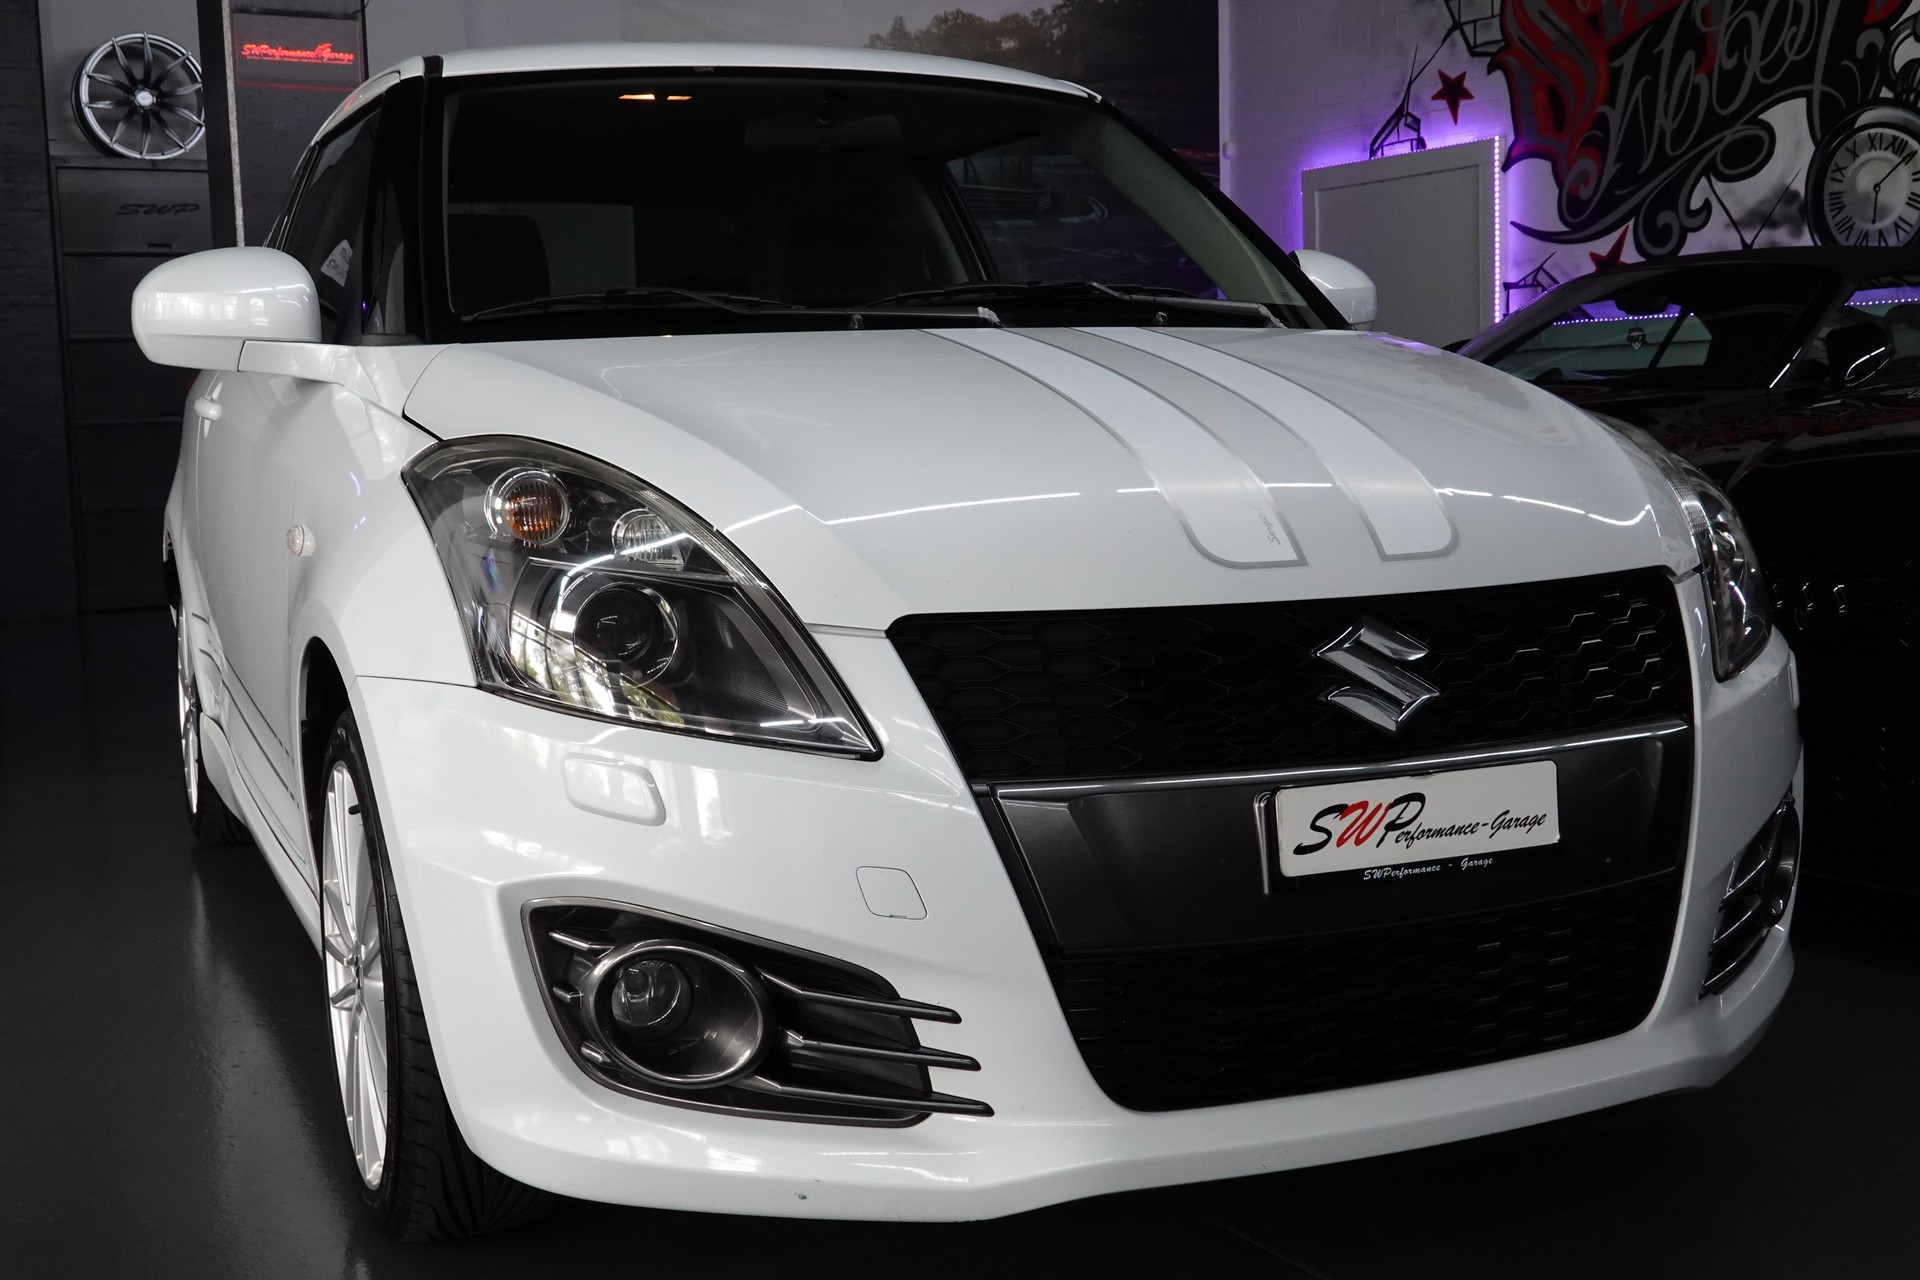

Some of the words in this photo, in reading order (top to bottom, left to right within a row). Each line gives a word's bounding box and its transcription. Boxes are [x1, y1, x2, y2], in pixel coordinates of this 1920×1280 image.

[115, 203, 200, 216] SWP
[1363, 864, 1441, 880] SWPerformance
[1460, 857, 1493, 871] Garage
